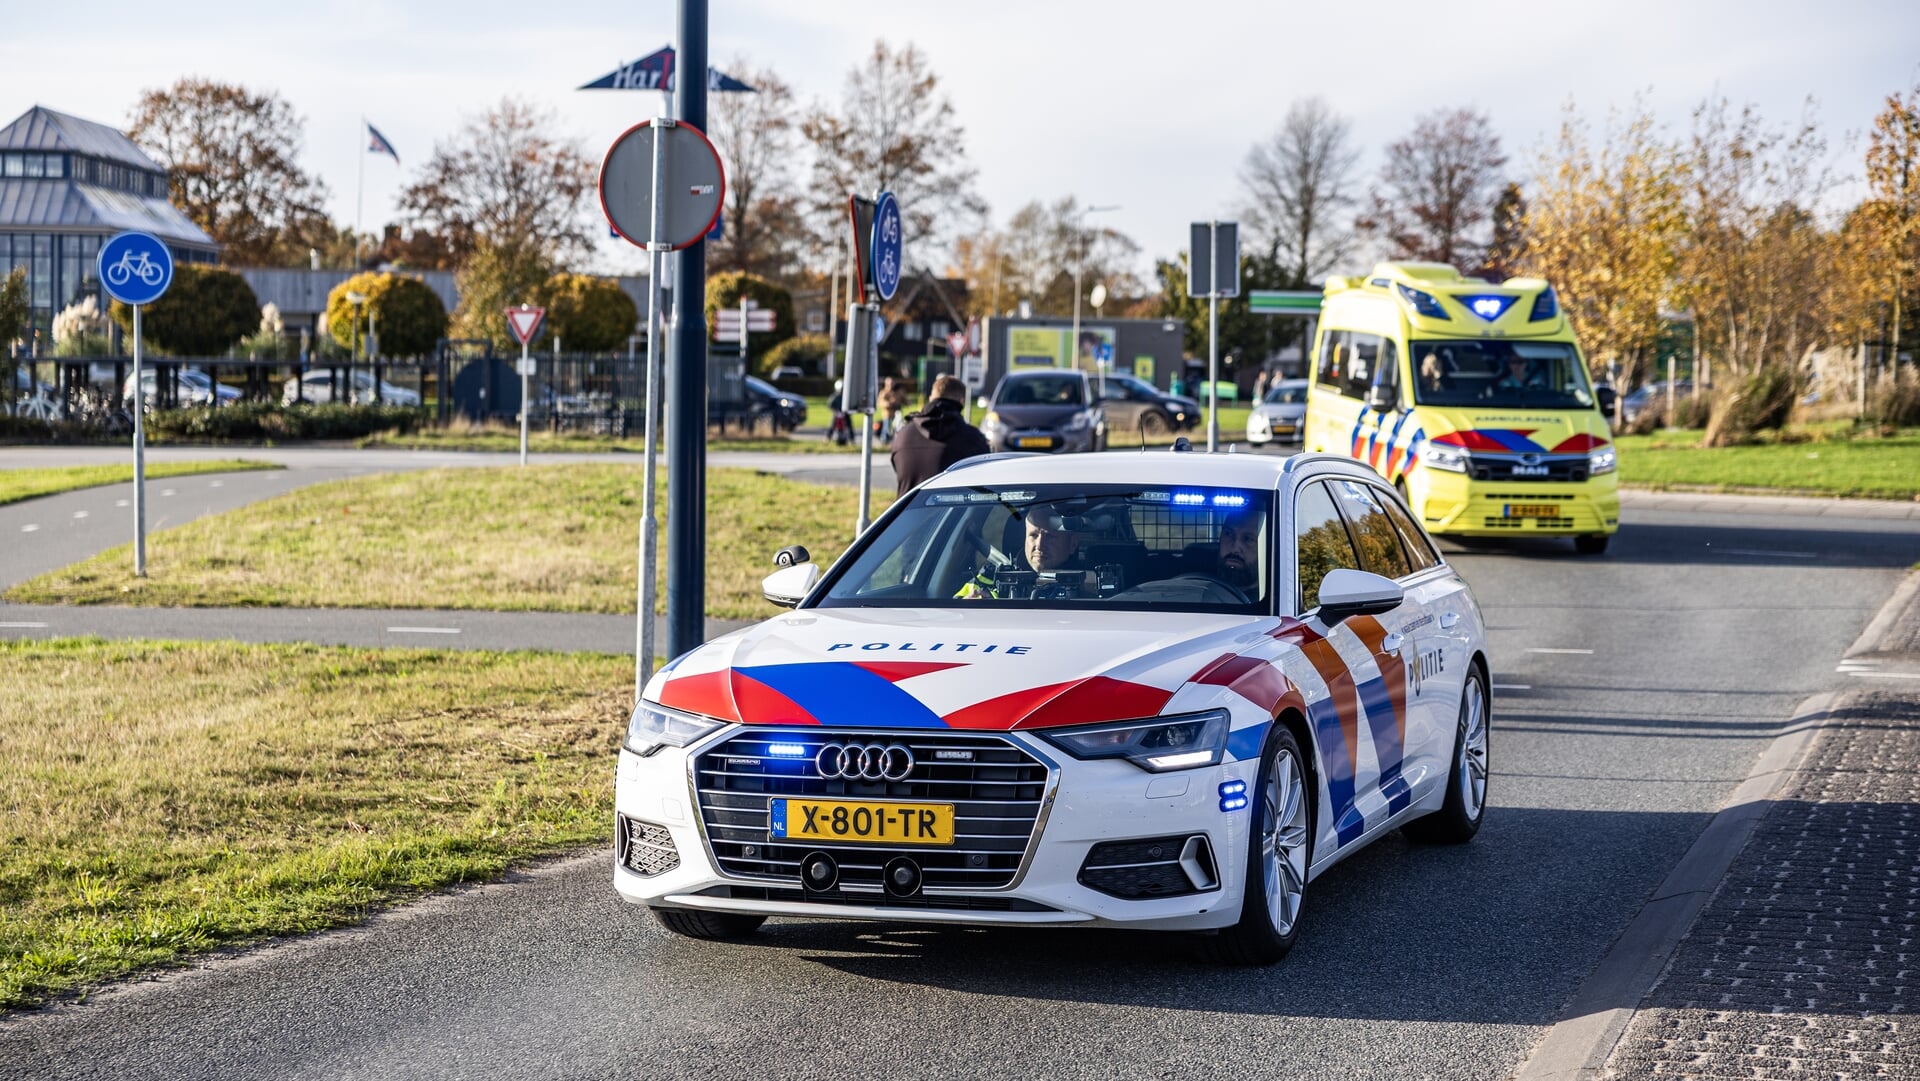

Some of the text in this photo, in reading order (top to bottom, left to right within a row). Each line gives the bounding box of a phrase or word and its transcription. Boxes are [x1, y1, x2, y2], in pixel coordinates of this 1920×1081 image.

[1512, 465, 1550, 475] MAN
[827, 642, 1033, 655] POLITIE
[773, 821, 785, 831] NL
[802, 805, 937, 838] X-801-TR
